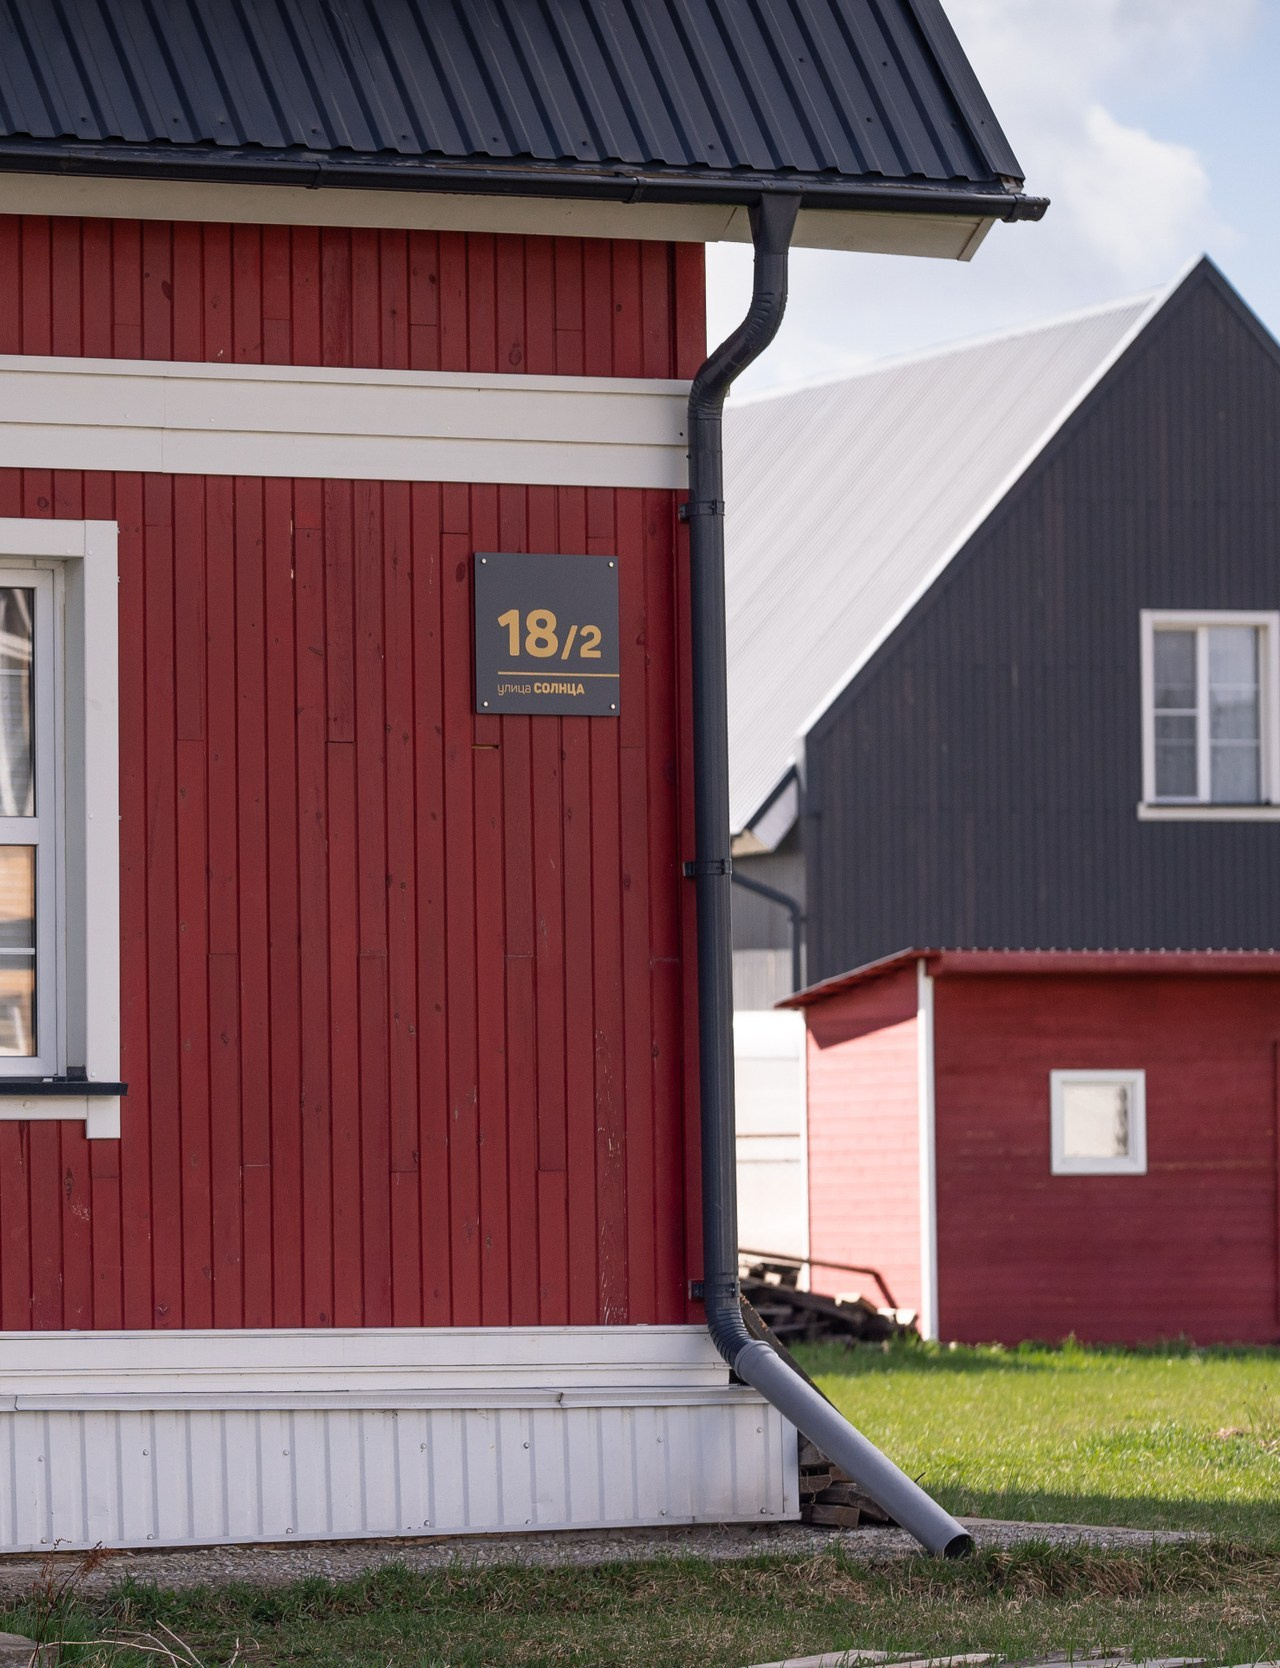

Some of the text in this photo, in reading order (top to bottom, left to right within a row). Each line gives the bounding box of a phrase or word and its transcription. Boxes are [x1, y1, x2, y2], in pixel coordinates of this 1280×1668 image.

[497, 609, 602, 660] 18/2
[497, 682, 585, 697] улица СОЛНЦА
